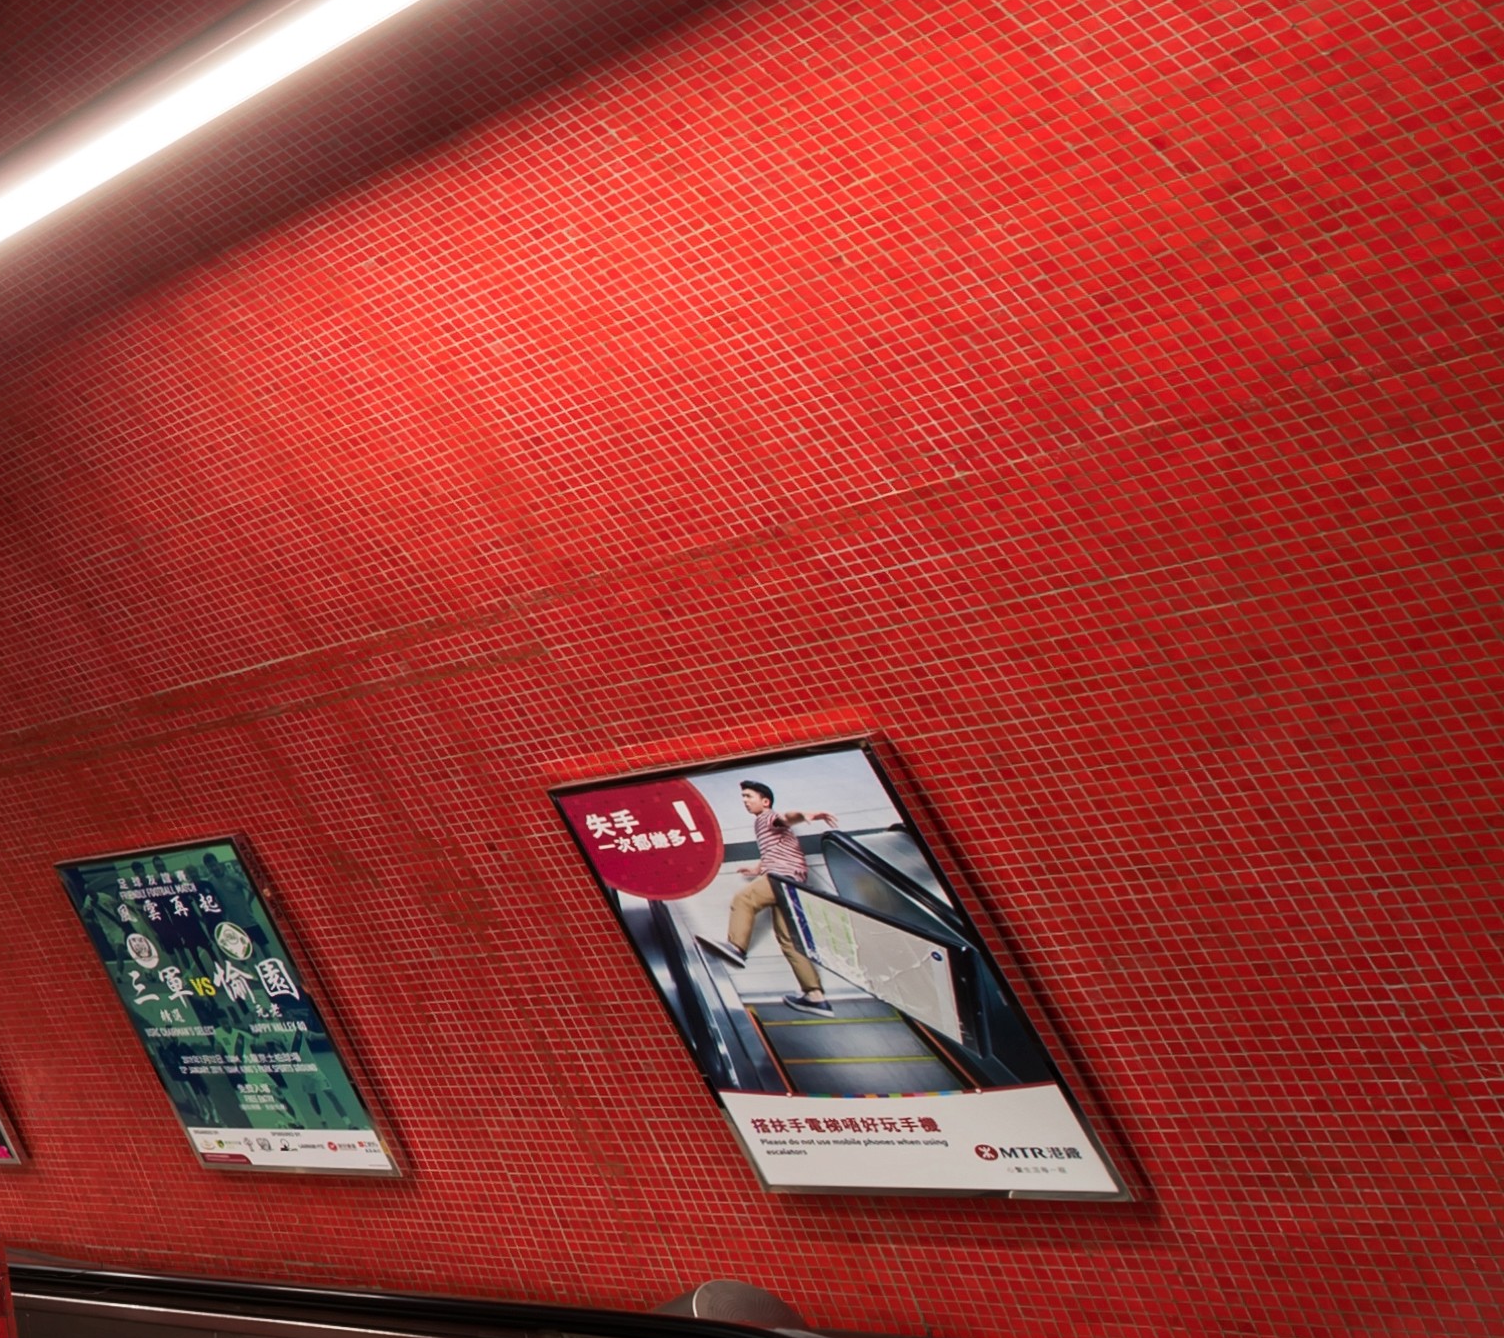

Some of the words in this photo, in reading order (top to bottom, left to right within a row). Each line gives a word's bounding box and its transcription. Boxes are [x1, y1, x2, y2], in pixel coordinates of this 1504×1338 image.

[585, 808, 640, 839] 失手
[116, 892, 222, 923] 風雲再起
[128, 965, 194, 1008] 三軍
[190, 976, 217, 997] VS
[213, 958, 300, 1004] 愉園
[750, 1116, 943, 1134] 搭扶手電梯唔好玩手機
[760, 1138, 788, 1146] Please
[789, 1138, 800, 1146] do
[801, 1138, 815, 1146] not
[832, 1138, 862, 1146] mobile
[863, 1138, 895, 1148] phones
[897, 1138, 921, 1146] when
[922, 1138, 949, 1148] using
[766, 1148, 808, 1156] escalators
[998, 1147, 1047, 1159] MTR
